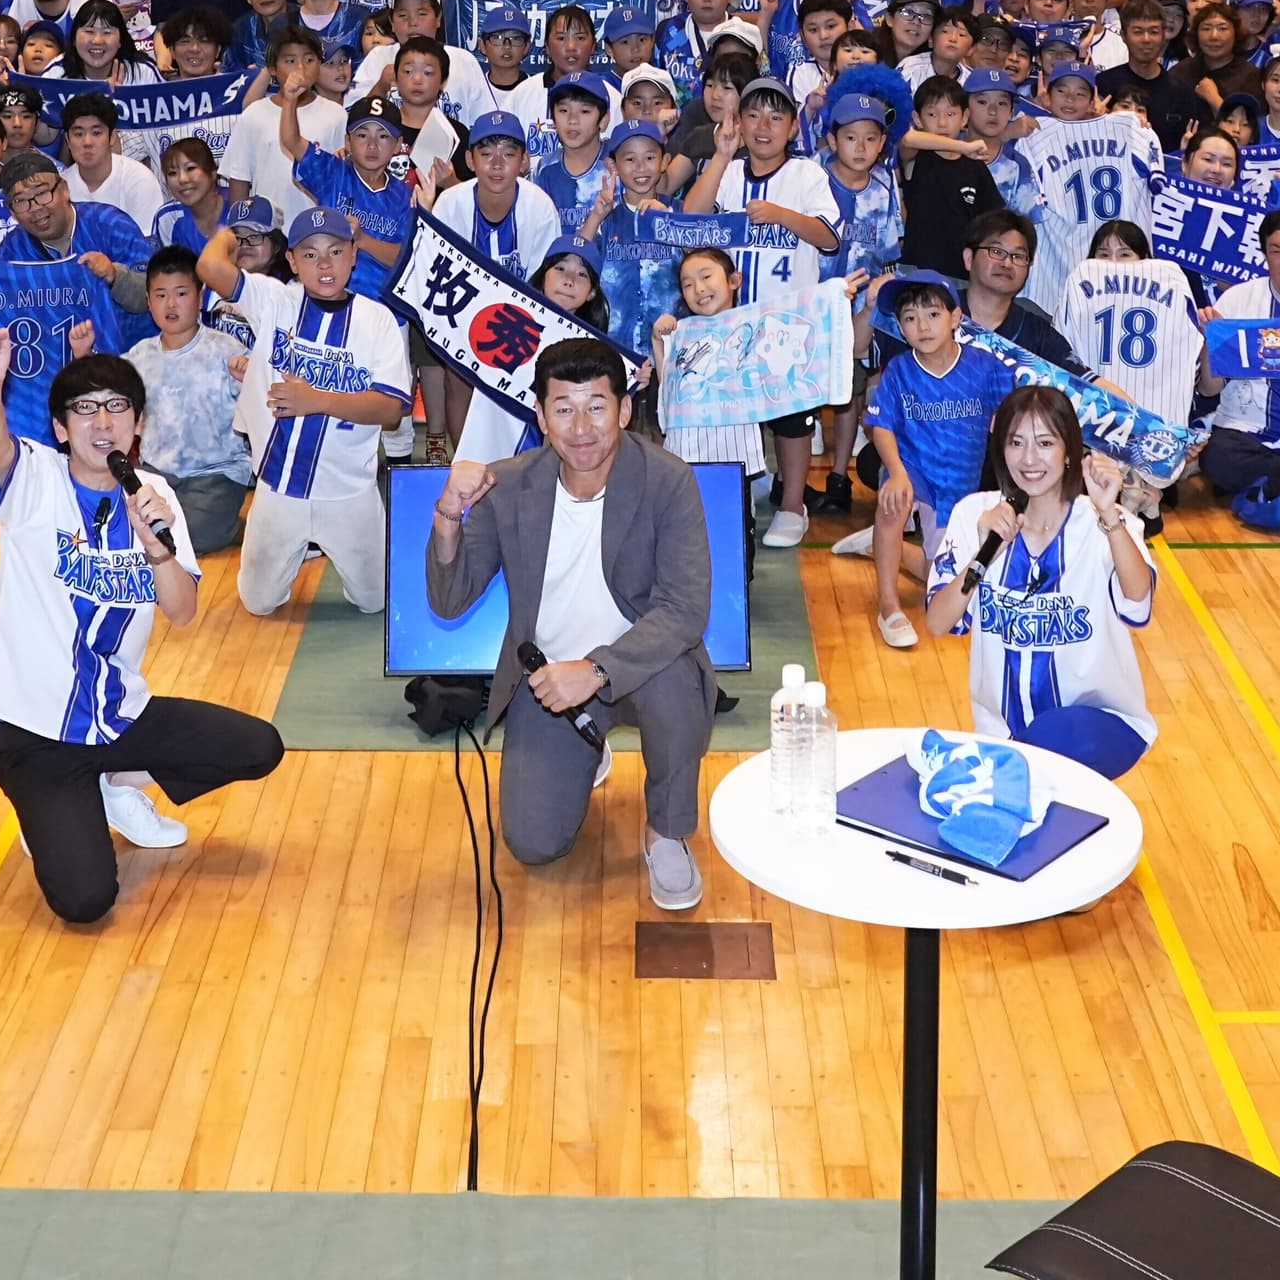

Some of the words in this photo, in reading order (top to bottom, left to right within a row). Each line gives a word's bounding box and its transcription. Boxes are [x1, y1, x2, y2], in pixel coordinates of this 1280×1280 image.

[370, 99, 383, 116] S
[1064, 165, 1122, 224] 18
[654, 216, 732, 246] BAYSTARS
[771, 255, 792, 282] 4
[1157, 243, 1205, 266] ASAHI
[430, 232, 501, 288] YOKOHAMA
[510, 289, 547, 315] DeNA
[1077, 274, 1174, 309] D.MIURA
[5, 314, 77, 380] 81
[425, 326, 481, 373] HUGO
[1094, 307, 1157, 368] 18
[324, 348, 354, 364] DeNA
[1238, 338, 1249, 369] I
[902, 391, 983, 420] YOKOHAMA
[1036, 596, 1074, 611] DeNA
